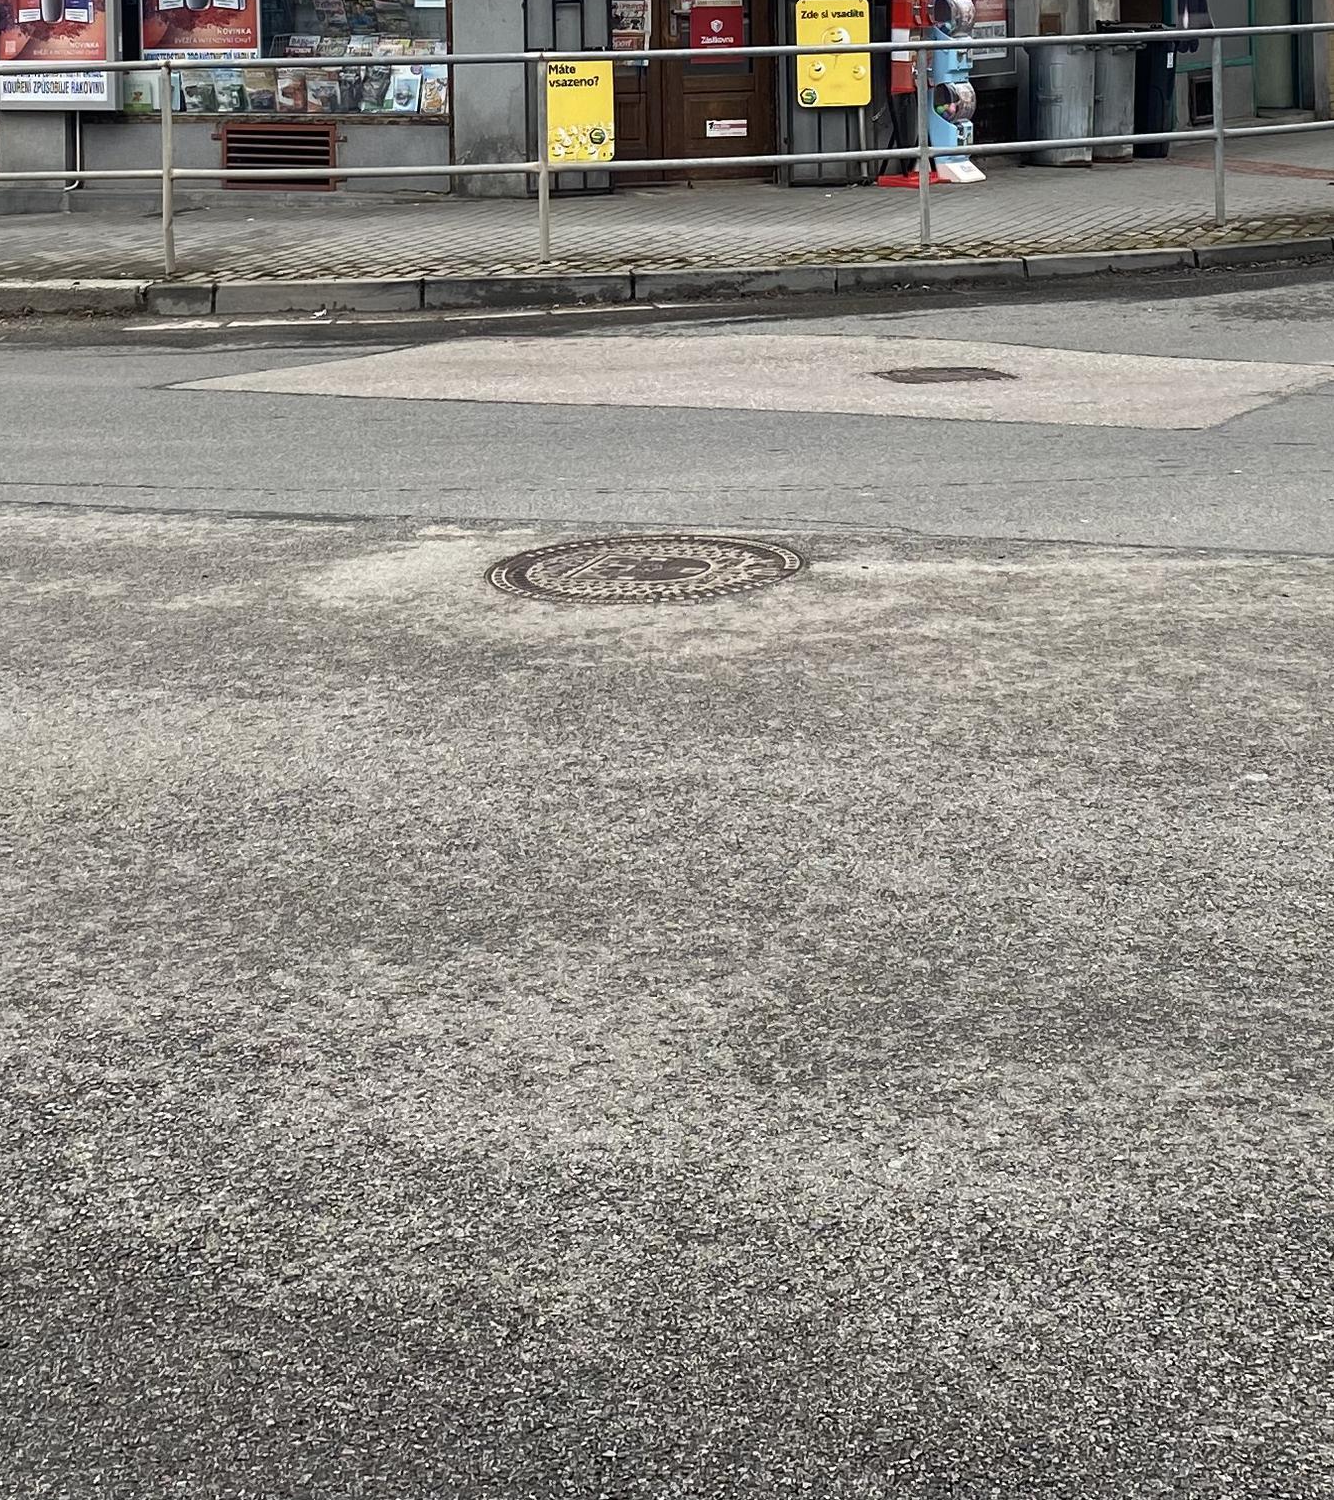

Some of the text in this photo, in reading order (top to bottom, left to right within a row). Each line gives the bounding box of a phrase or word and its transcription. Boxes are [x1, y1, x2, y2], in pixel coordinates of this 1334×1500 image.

[801, 9, 819, 19] Zde
[700, 36, 735, 45] Zásilkovna
[548, 63, 577, 75] Máte
[548, 76, 599, 88] vsazeno?
